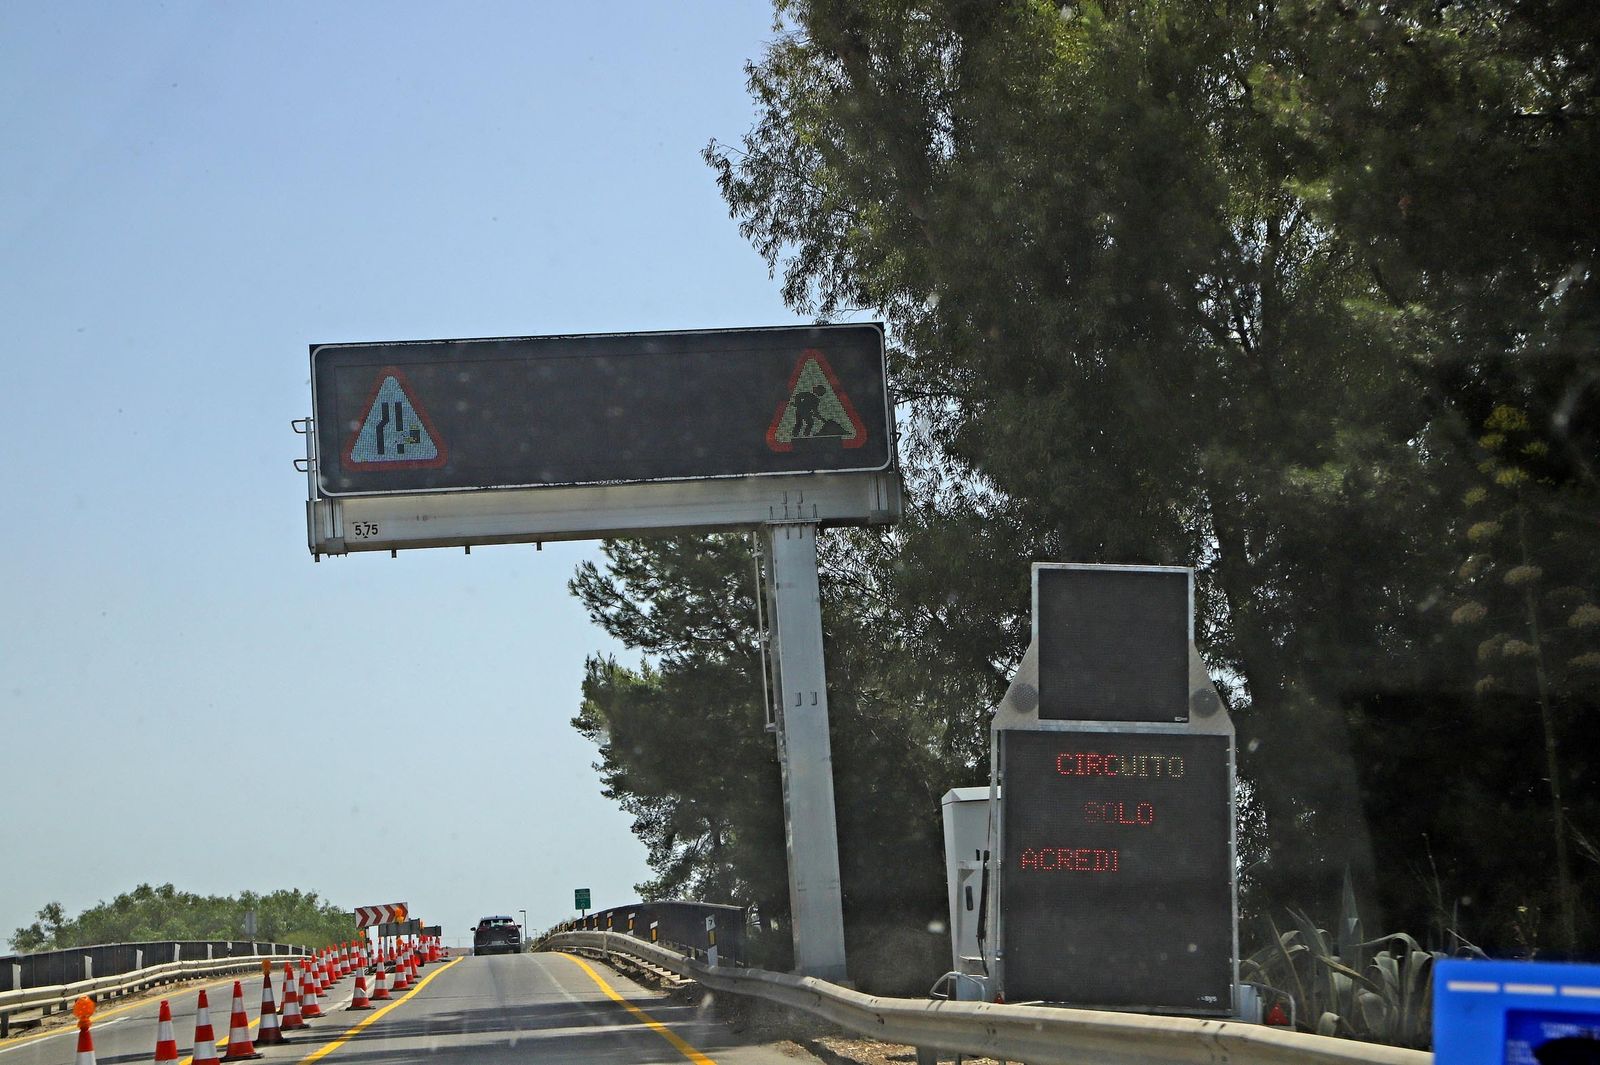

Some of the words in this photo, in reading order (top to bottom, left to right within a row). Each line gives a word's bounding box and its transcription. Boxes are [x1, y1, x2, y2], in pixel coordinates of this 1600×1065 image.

[1056, 753, 1185, 778] CIRCUITO
[1084, 801, 1154, 825] SOLO
[1021, 848, 1120, 872] ACREDI
